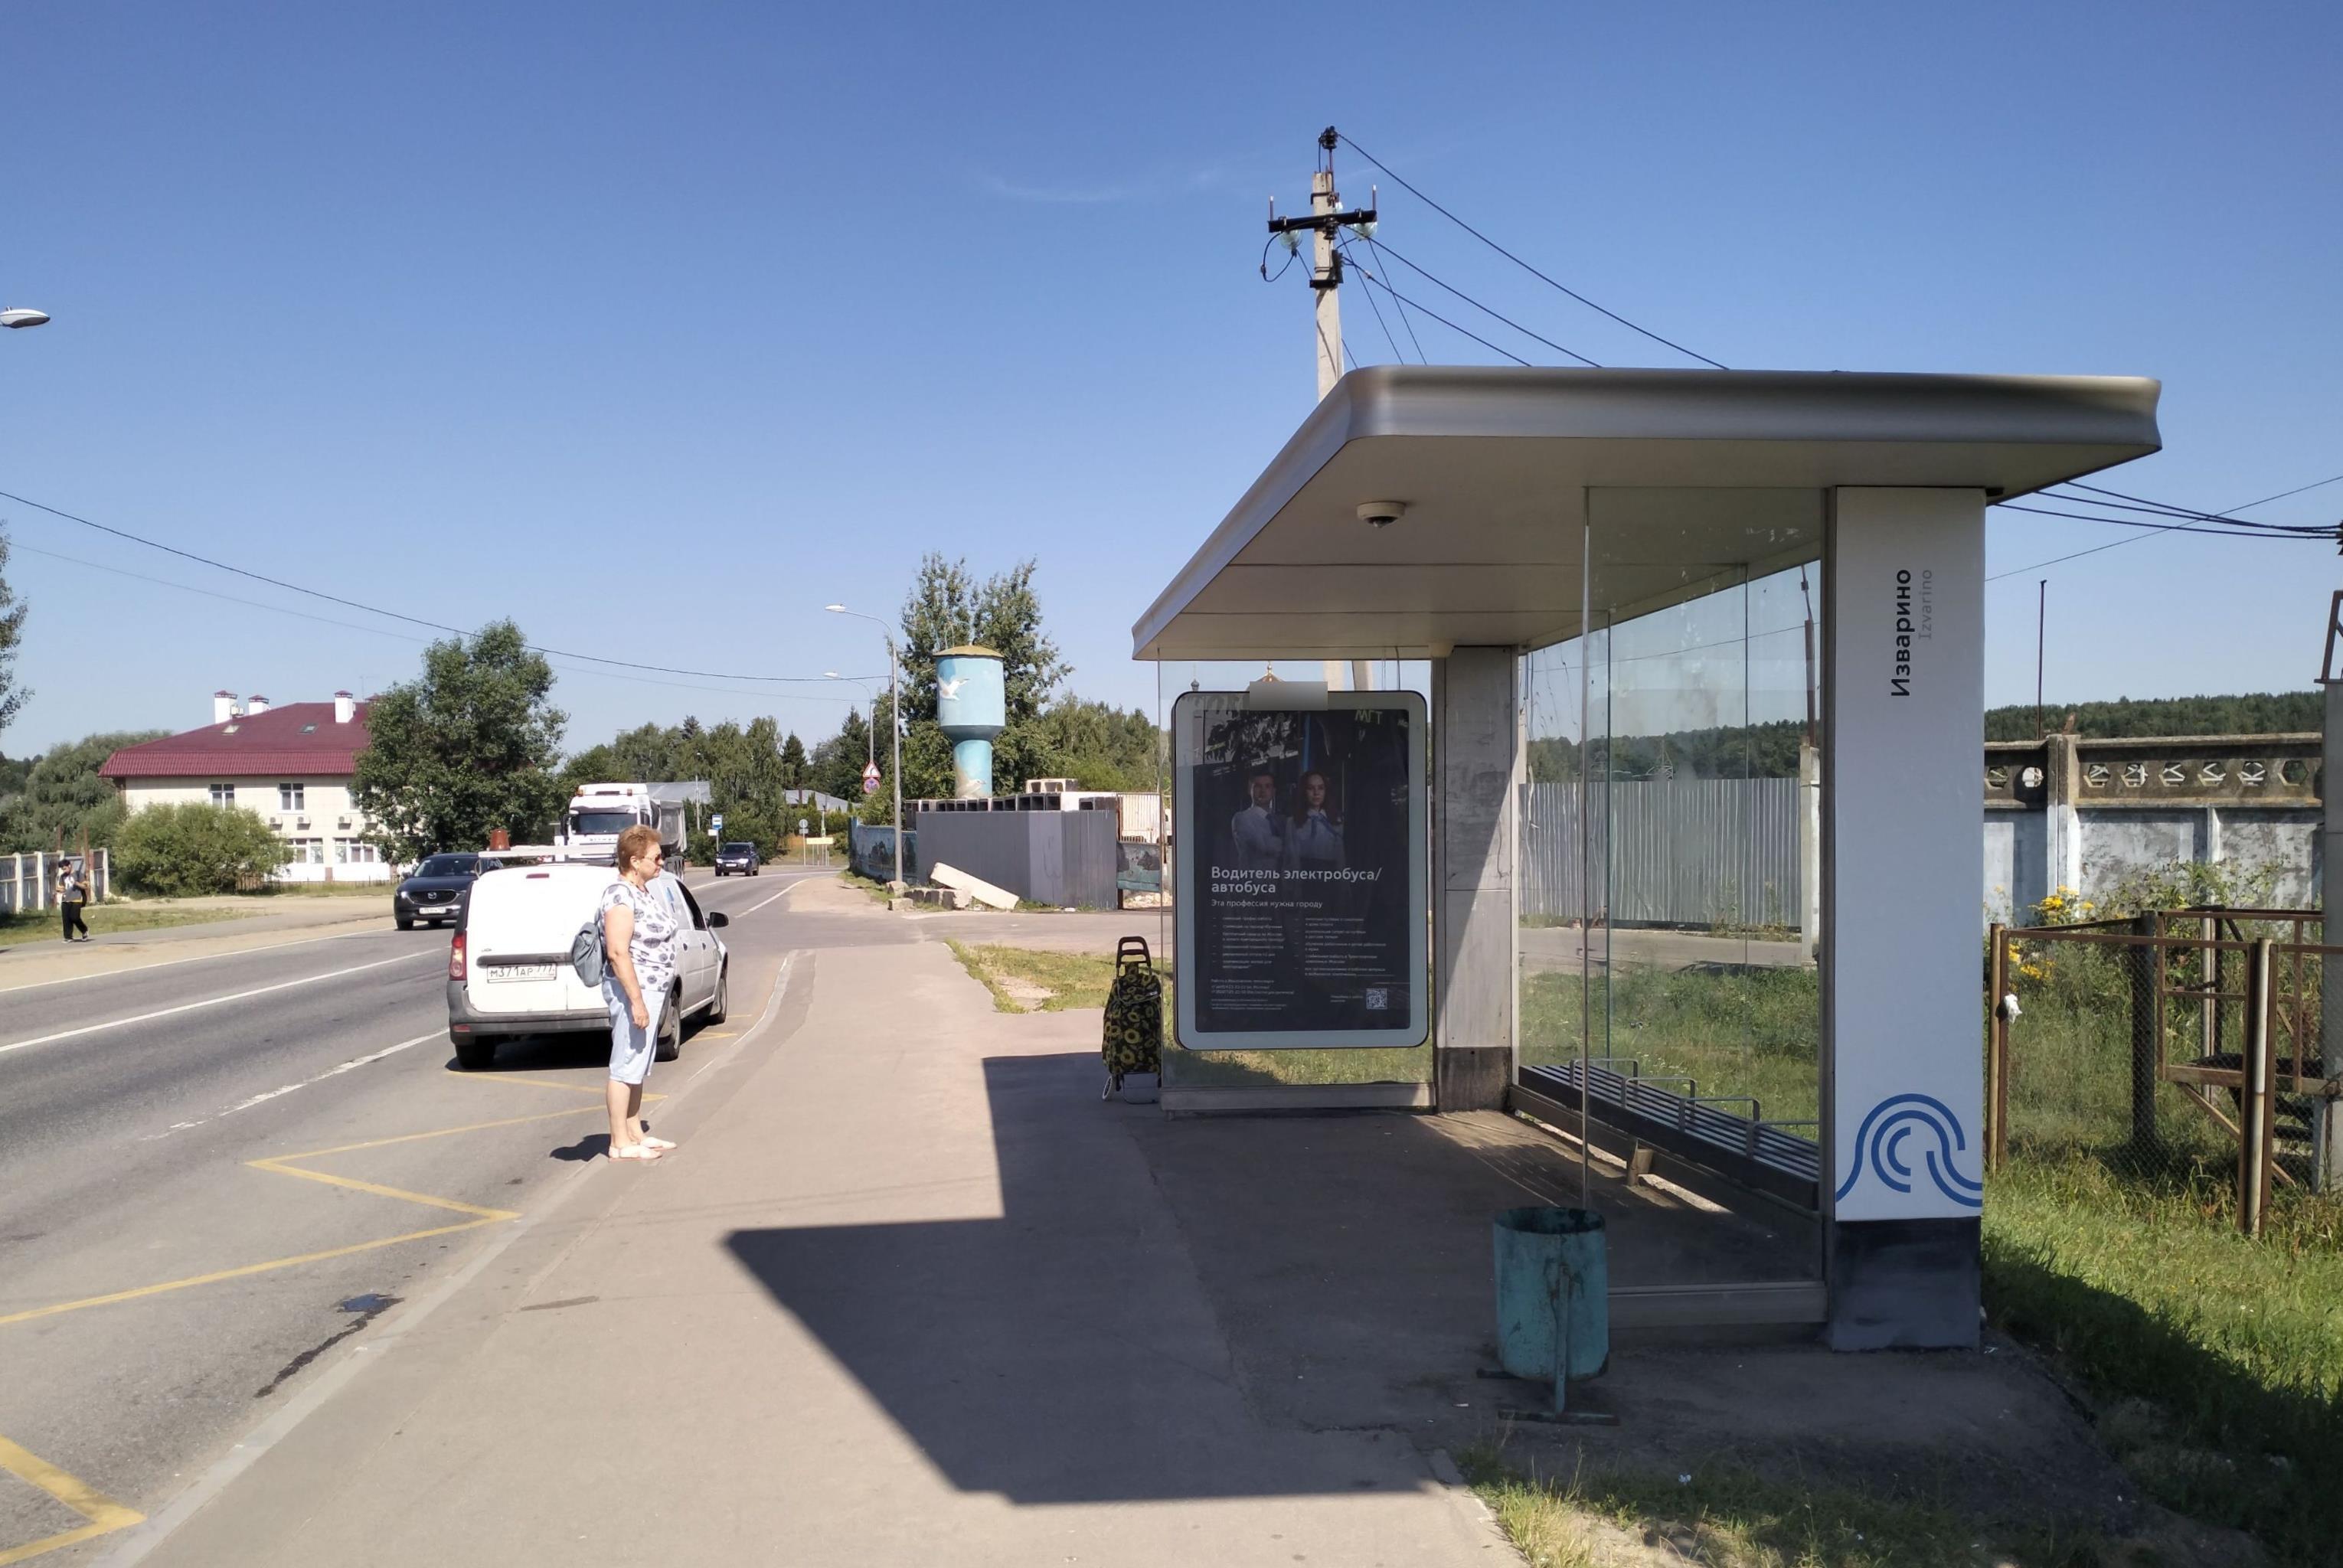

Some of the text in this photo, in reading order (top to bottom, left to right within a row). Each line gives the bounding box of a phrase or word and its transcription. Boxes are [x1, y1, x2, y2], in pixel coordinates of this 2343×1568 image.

[1918, 570, 1933, 640] Izvarino
[1890, 569, 1915, 696] Изварино
[1211, 866, 1382, 883] Водитель электробуса/
[1211, 880, 1276, 896] автобуса
[1211, 899, 1225, 907] Эта
[1226, 899, 1268, 909] профессия
[1270, 900, 1294, 909] нужна
